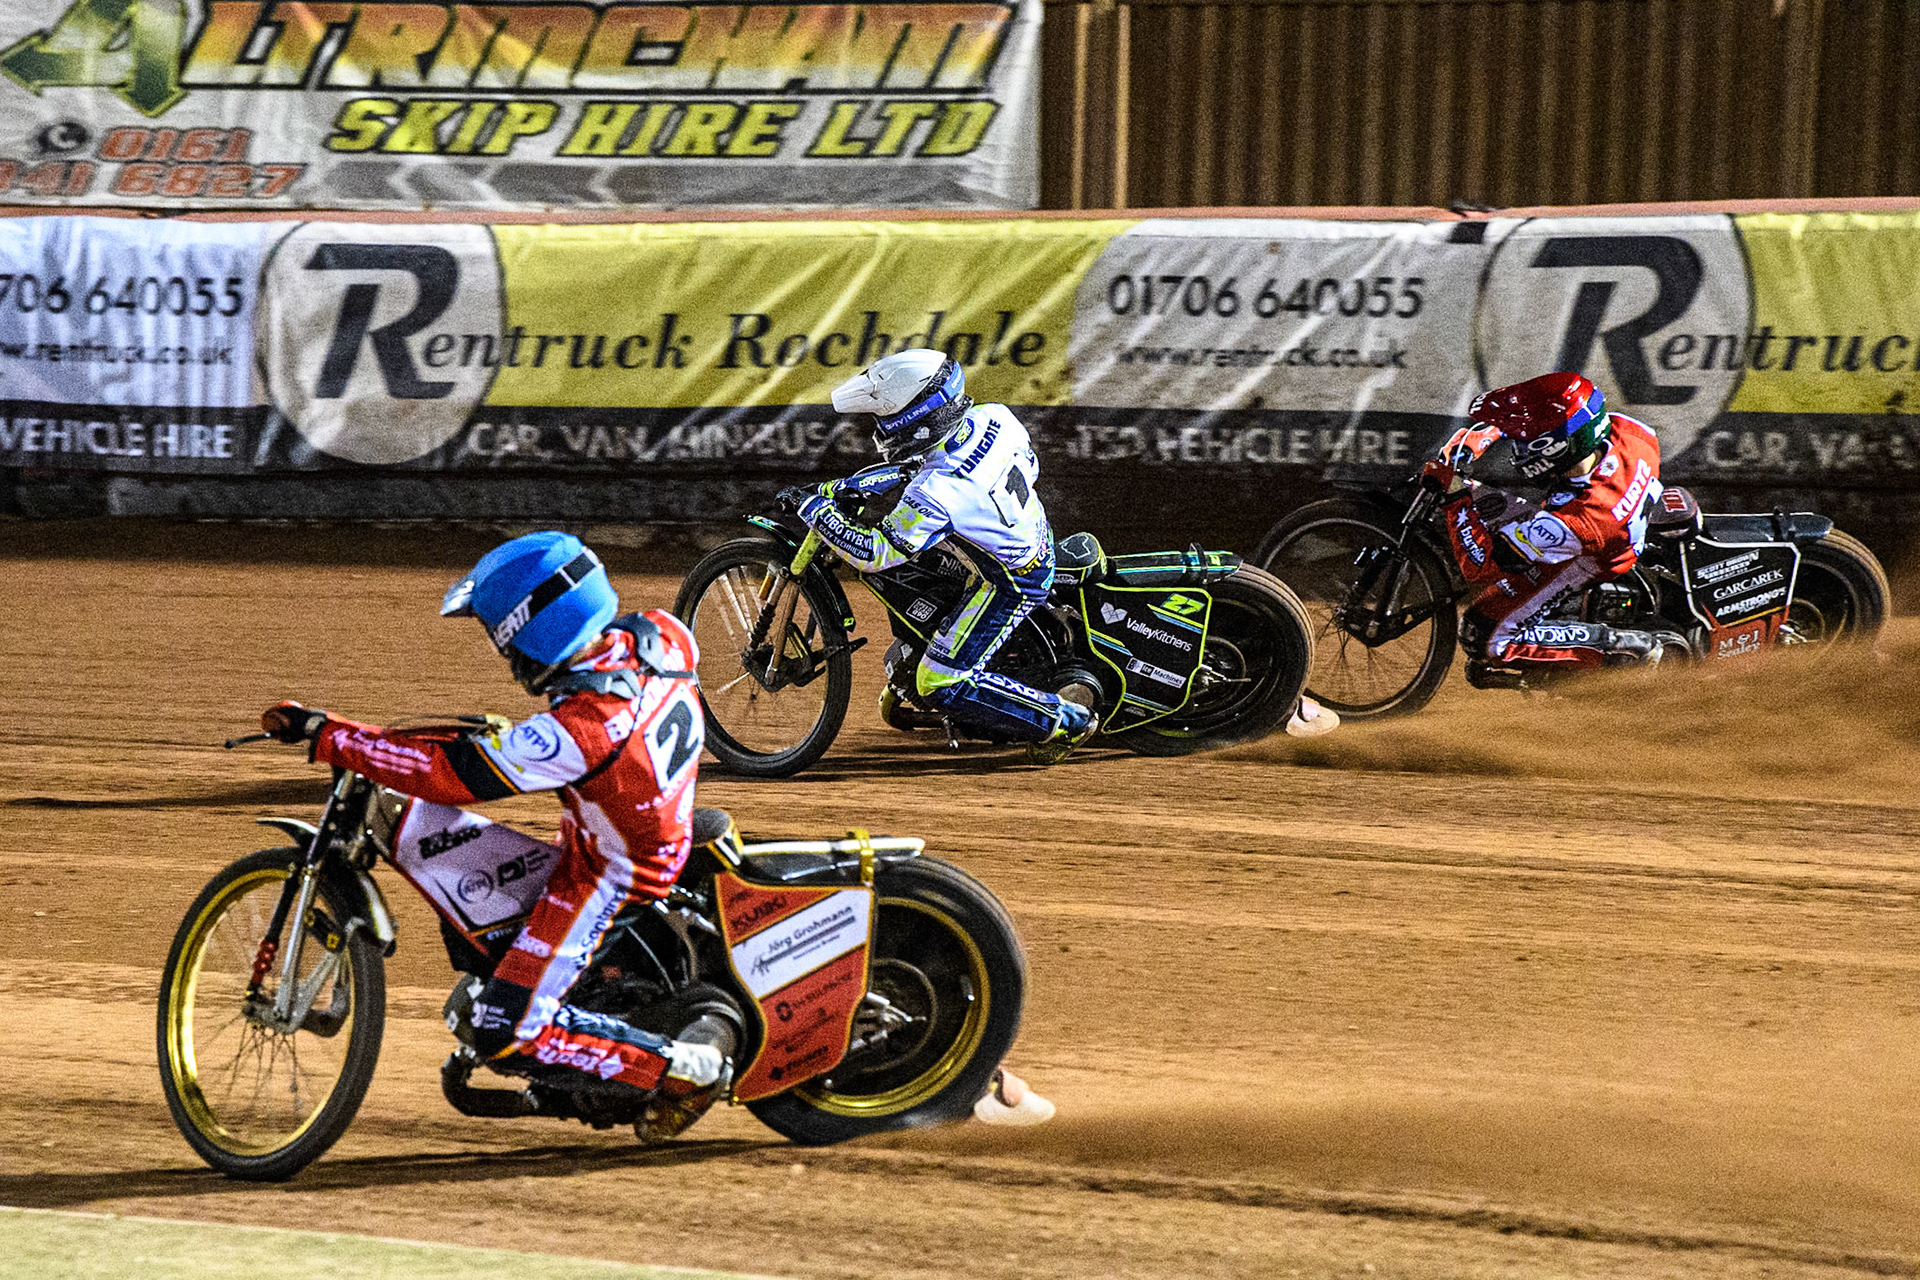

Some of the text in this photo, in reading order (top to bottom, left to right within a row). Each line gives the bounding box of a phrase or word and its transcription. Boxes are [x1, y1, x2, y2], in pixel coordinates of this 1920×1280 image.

[100, 126, 252, 162] 0161
[322, 97, 1001, 158] SKIP HIRE LTD
[109, 160, 308, 199] 6827
[86, 275, 242, 317] 640055
[1107, 274, 1426, 319] 01706 640055
[301, 242, 695, 400] Rentruck
[152, 422, 234, 459] HIRE
[951, 418, 1002, 479] TUNGATE
[1610, 457, 1652, 522] KURTZ
[1159, 592, 1206, 616] 27
[1712, 569, 1784, 600] GARCAREK
[1125, 616, 1193, 653] ValleyKitchens
[1153, 668, 1184, 686] Machines
[656, 699, 700, 782] 2
[793, 905, 853, 942] Grohmann
